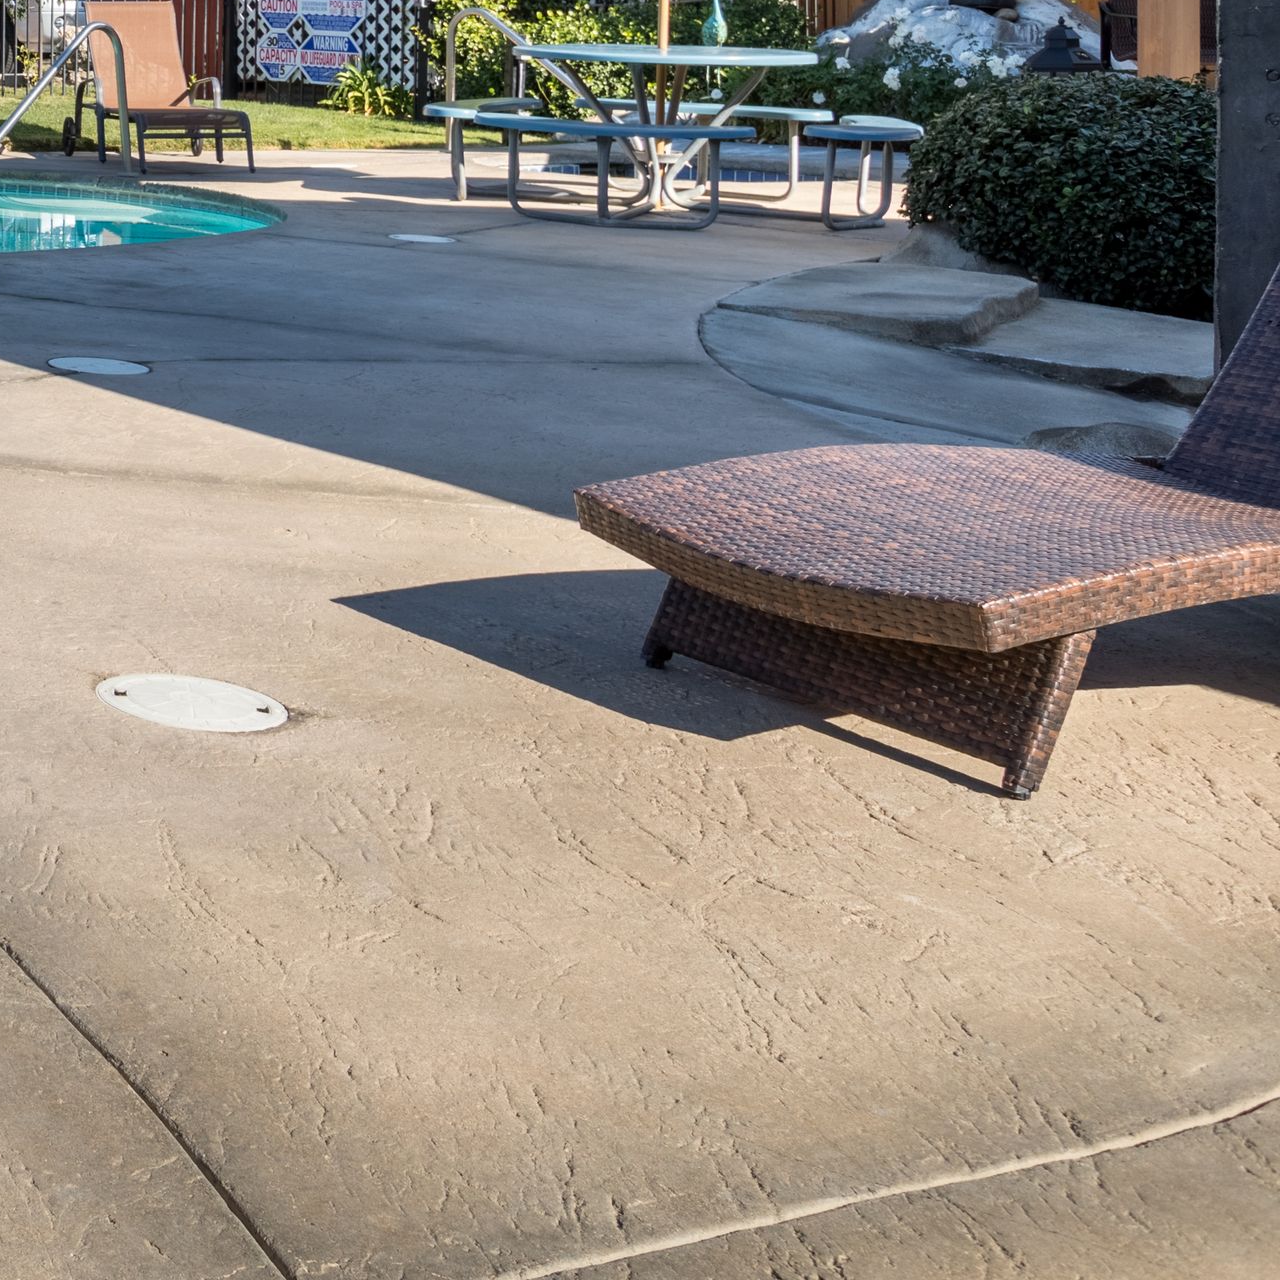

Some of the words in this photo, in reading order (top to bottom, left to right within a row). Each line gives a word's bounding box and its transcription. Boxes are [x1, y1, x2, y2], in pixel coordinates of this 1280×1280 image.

[260, 0, 298, 12] CAUTION
[329, 0, 345, 9] POOL
[351, 1, 363, 9] SPA
[266, 37, 278, 46] 30
[313, 36, 349, 51] WARNING
[259, 48, 297, 63] CAPACITY
[301, 51, 308, 64] NO
[309, 51, 337, 66] LIFEGUARD
[279, 65, 285, 75] 5
